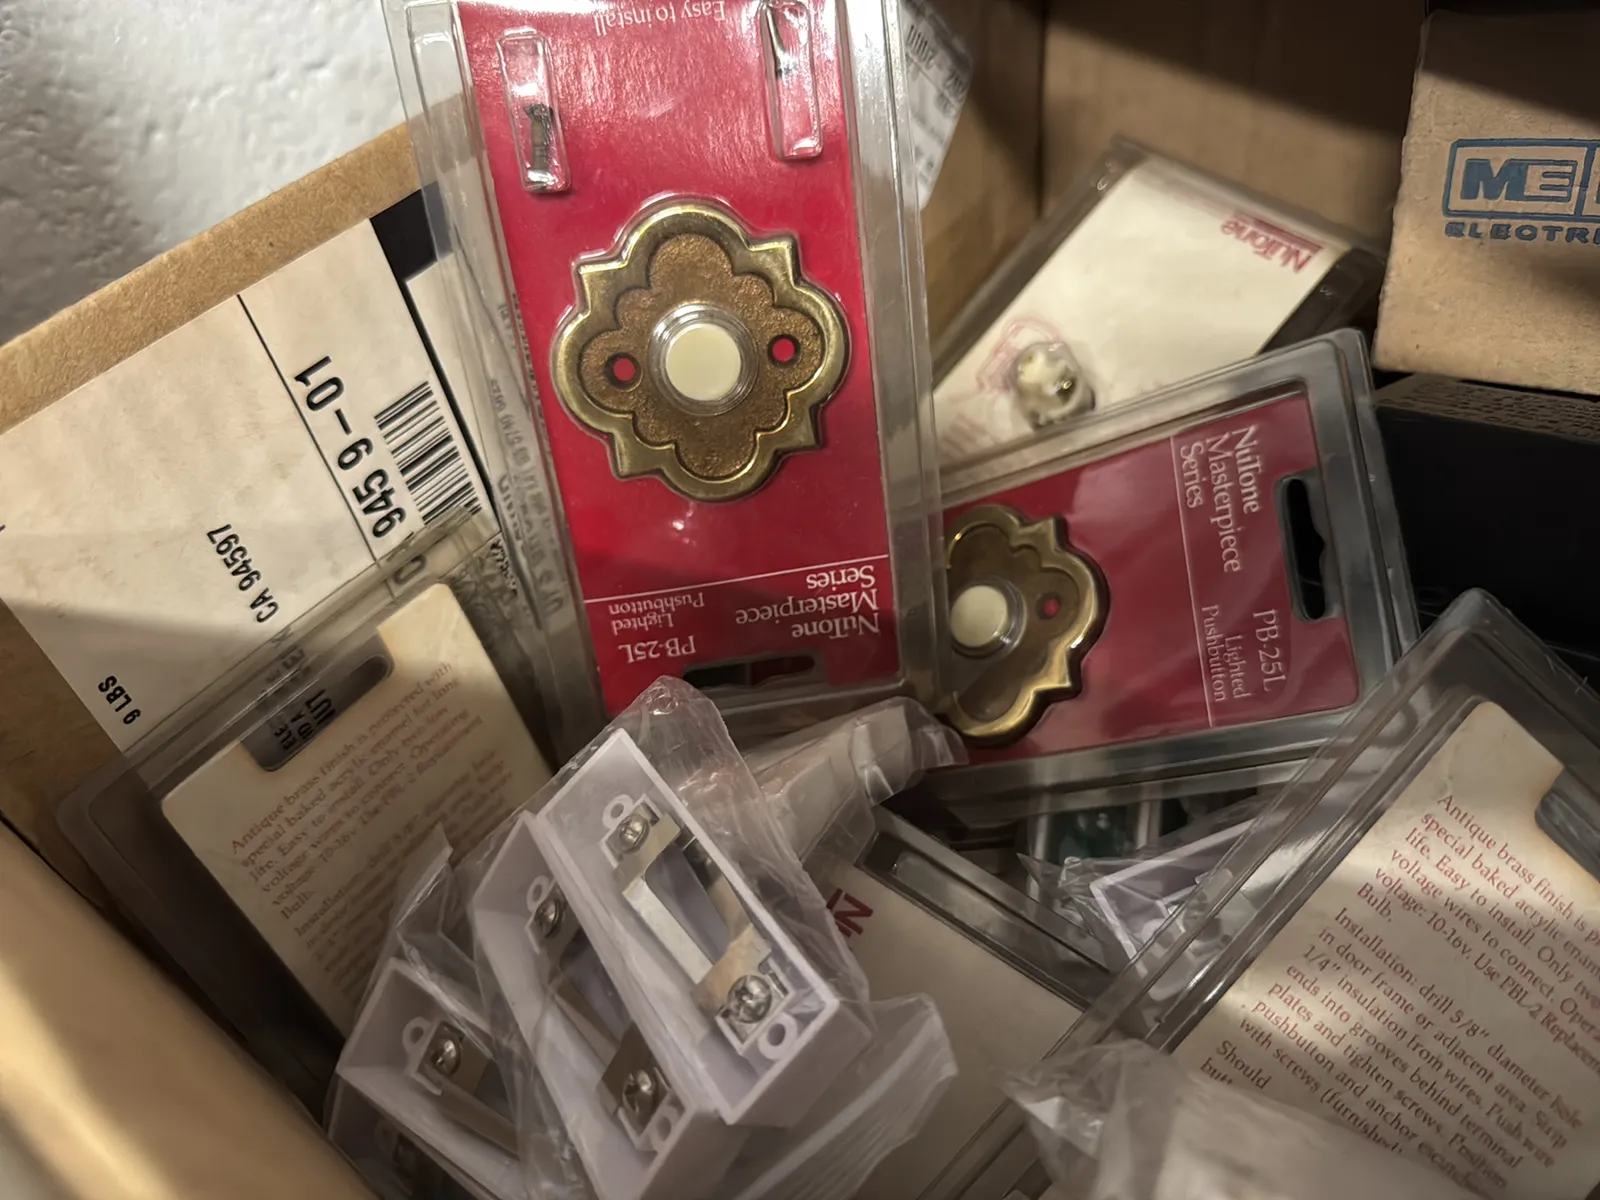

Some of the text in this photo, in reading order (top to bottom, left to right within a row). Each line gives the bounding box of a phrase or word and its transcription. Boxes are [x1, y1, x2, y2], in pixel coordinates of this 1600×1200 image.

[594, 0, 725, 36] Easy to install
[1222, 218, 1311, 273] NuTone
[352, 469, 405, 537] 945
[1181, 441, 1206, 508] Series
[1205, 432, 1241, 572] Masterpiece
[1232, 425, 1261, 513] NuTone
[207, 524, 278, 623] CA 94597
[609, 593, 704, 614] Pushbutton
[736, 586, 878, 623] Masterpiece
[806, 565, 875, 590] Series
[612, 610, 673, 635] Lighted
[618, 636, 696, 663] PB-25L
[792, 613, 879, 639] NuTone
[1202, 605, 1226, 701] Pushbutton
[1253, 609, 1285, 691] PB-25L
[98, 675, 142, 725] 9 LBS
[1221, 635, 1251, 698] Lighted
[1357, 882, 1391, 922] Bulb.
[1403, 826, 1435, 861] life.
[1436, 854, 1470, 890] Easy
[1469, 886, 1490, 908] to
[1538, 946, 1573, 983] Only
[1414, 814, 1474, 859] special
[1472, 853, 1519, 899] baked
[1512, 896, 1566, 942] acrylic
[1437, 795, 1496, 849] Antique
[1497, 843, 1534, 883] brass
[1534, 878, 1573, 920] finish
[1572, 914, 1589, 933] is
[1376, 868, 1426, 916] voltage:
[1427, 912, 1472, 959] 10-16v.
[1474, 953, 1500, 980] Use
[1392, 849, 1442, 898] voltage
[1444, 897, 1481, 933] wires
[1480, 929, 1501, 950] to
[1500, 949, 1554, 1002] connect.
[1268, 983, 1312, 1021] plates
[1314, 1021, 1346, 1046] and
[1344, 1044, 1393, 1092] tighten
[1317, 927, 1337, 947] in
[1336, 944, 1372, 975] door
[1371, 972, 1414, 1014] frame
[1414, 1011, 1436, 1032] or
[1434, 1032, 1493, 1083] adjacent
[1335, 908, 1417, 985] Installation:
[1419, 984, 1453, 1014] drill
[1487, 1044, 1549, 1099] diameter
[1338, 975, 1407, 1040] insulation
[1407, 1035, 1443, 1071] from
[1217, 1040, 1271, 1090] Should
[1236, 1016, 1274, 1052] with
[1273, 1048, 1320, 1093] screws
[1252, 1001, 1334, 1073] pushbutton
[1335, 1072, 1368, 1098] and
[1366, 1099, 1418, 1140] anchor
[1287, 966, 1523, 1168] ends into grooves behind terminal
